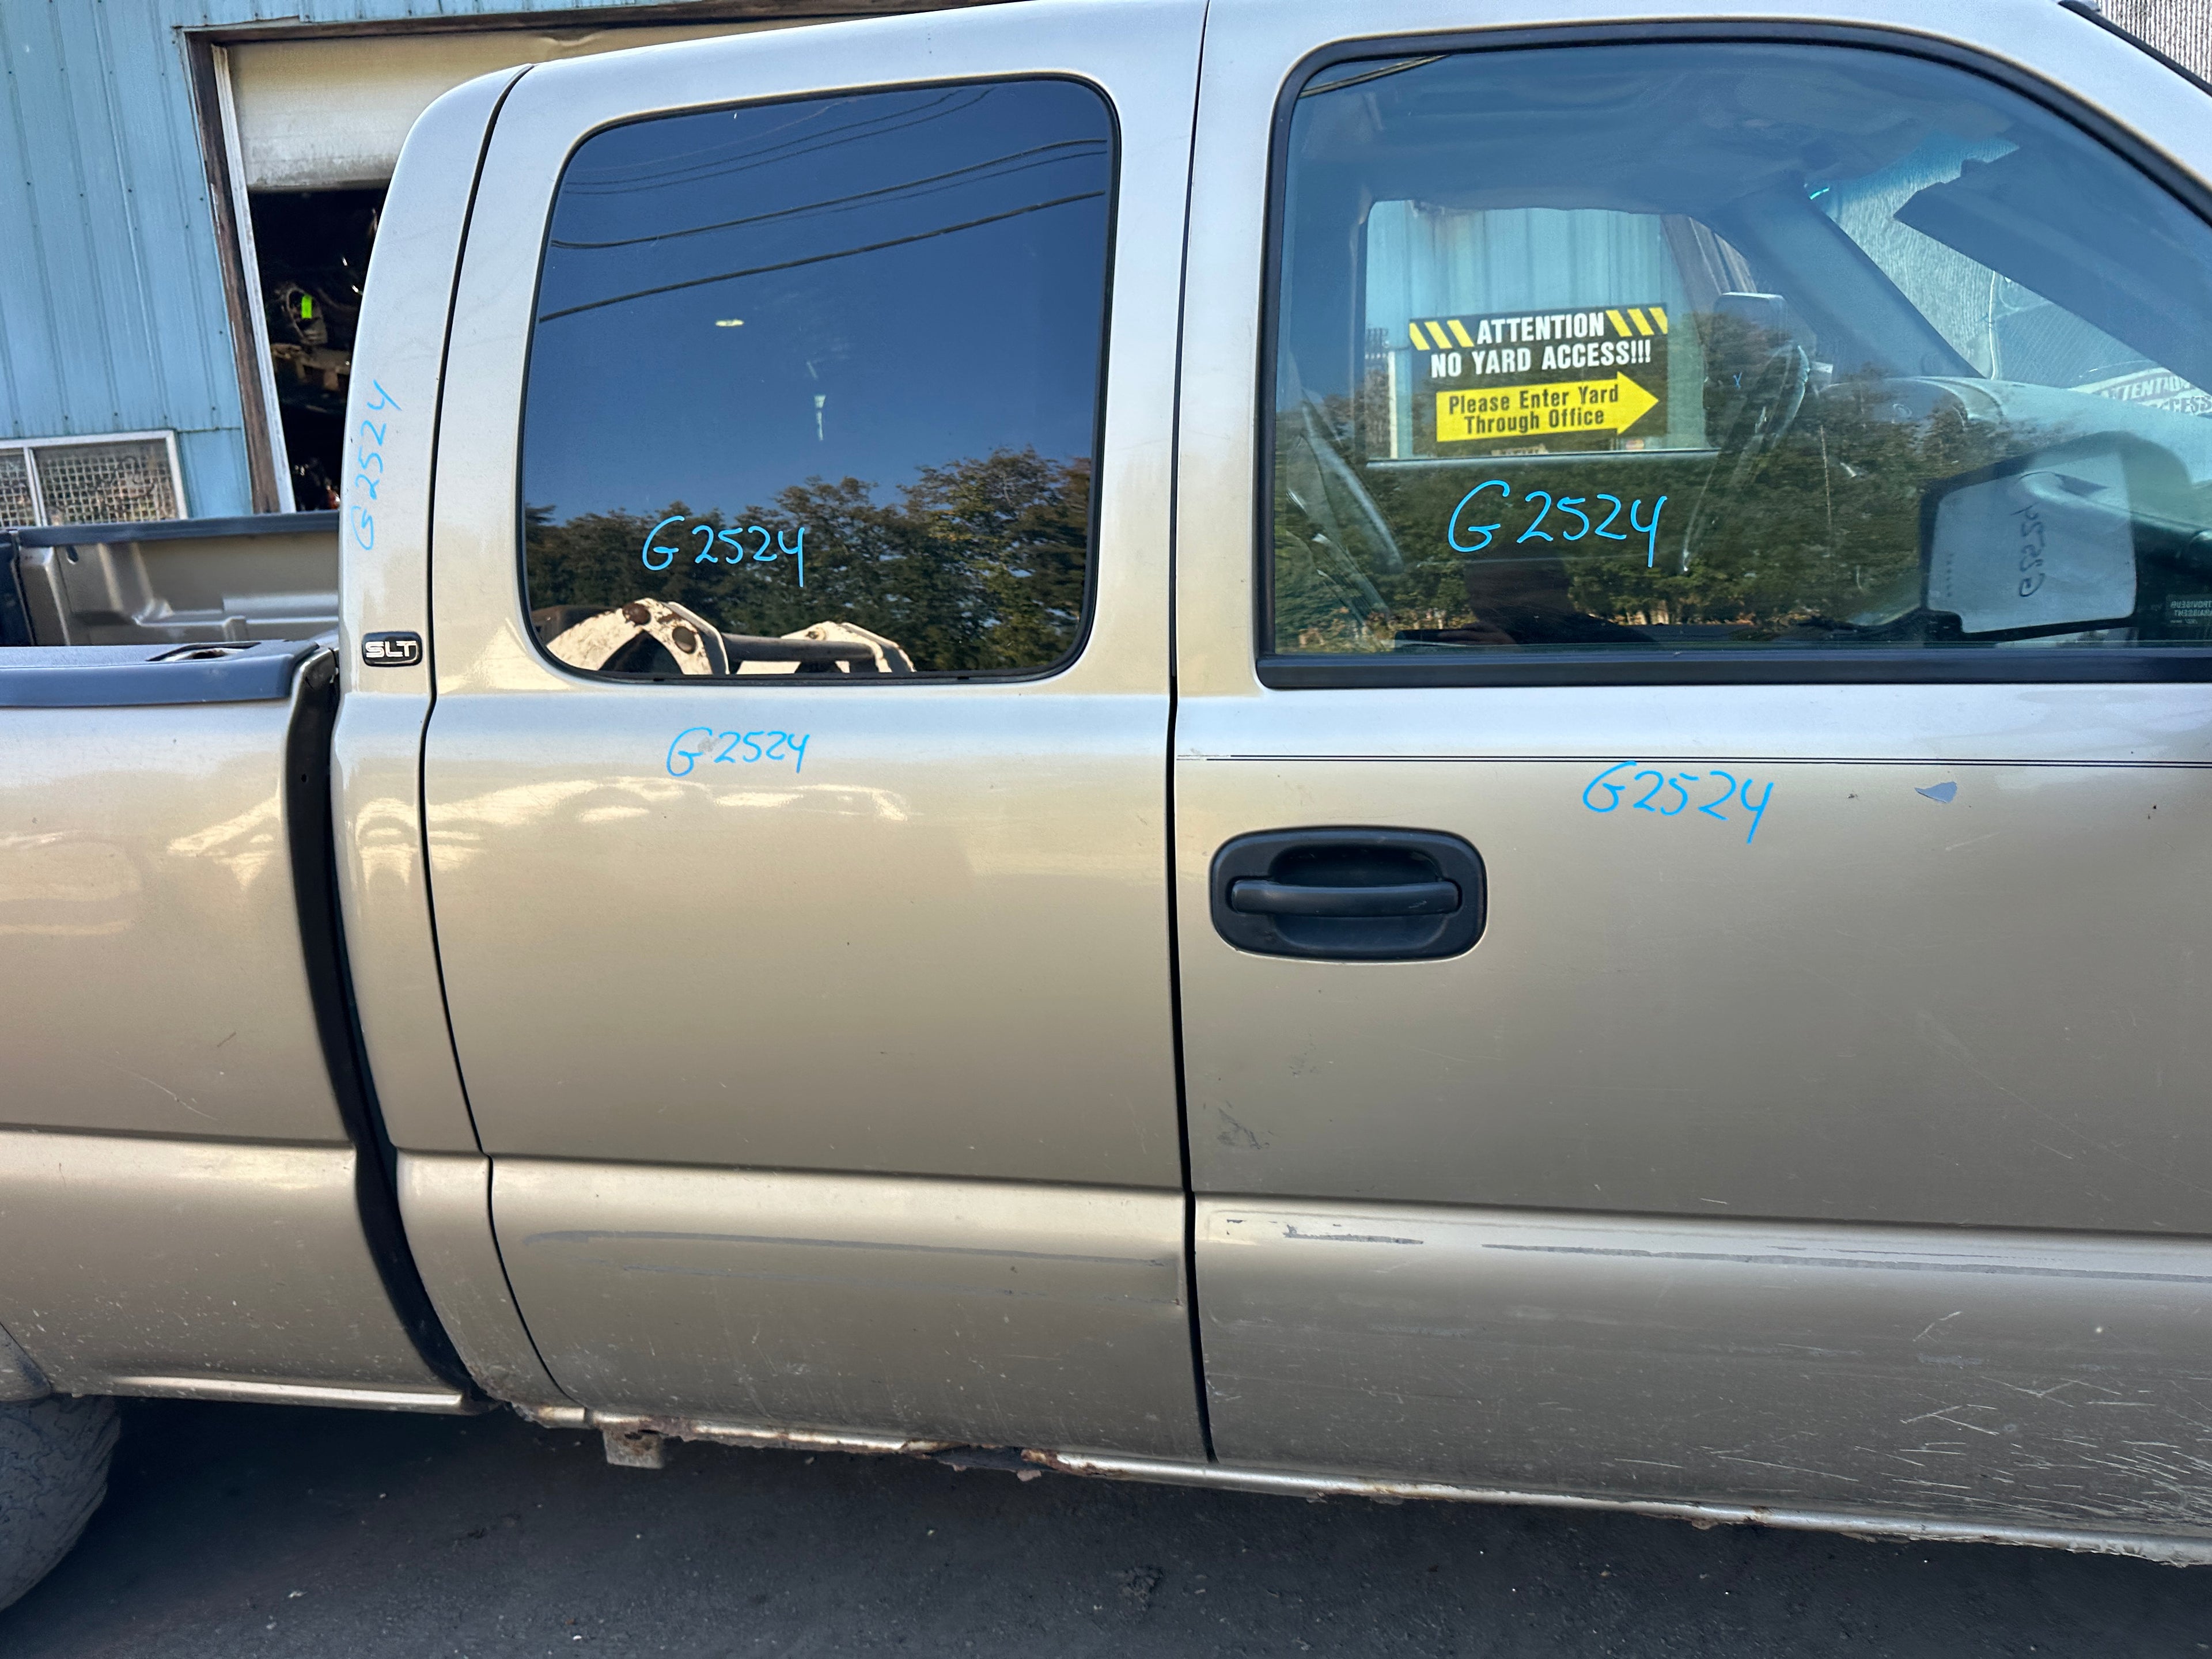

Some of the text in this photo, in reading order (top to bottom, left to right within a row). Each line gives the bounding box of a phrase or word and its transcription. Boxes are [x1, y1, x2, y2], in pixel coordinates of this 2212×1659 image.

[1476, 312, 1605, 345] ATTENTION
[1430, 339, 1652, 378] NO YARD ACCESS!!!
[1448, 384, 1619, 415] Please Enter Yard
[1464, 408, 1604, 435] Through Office
[350, 379, 402, 551] G2524
[365, 641, 417, 658] SLT
[667, 726, 810, 776] G2524
[1583, 760, 1774, 843] G2524
